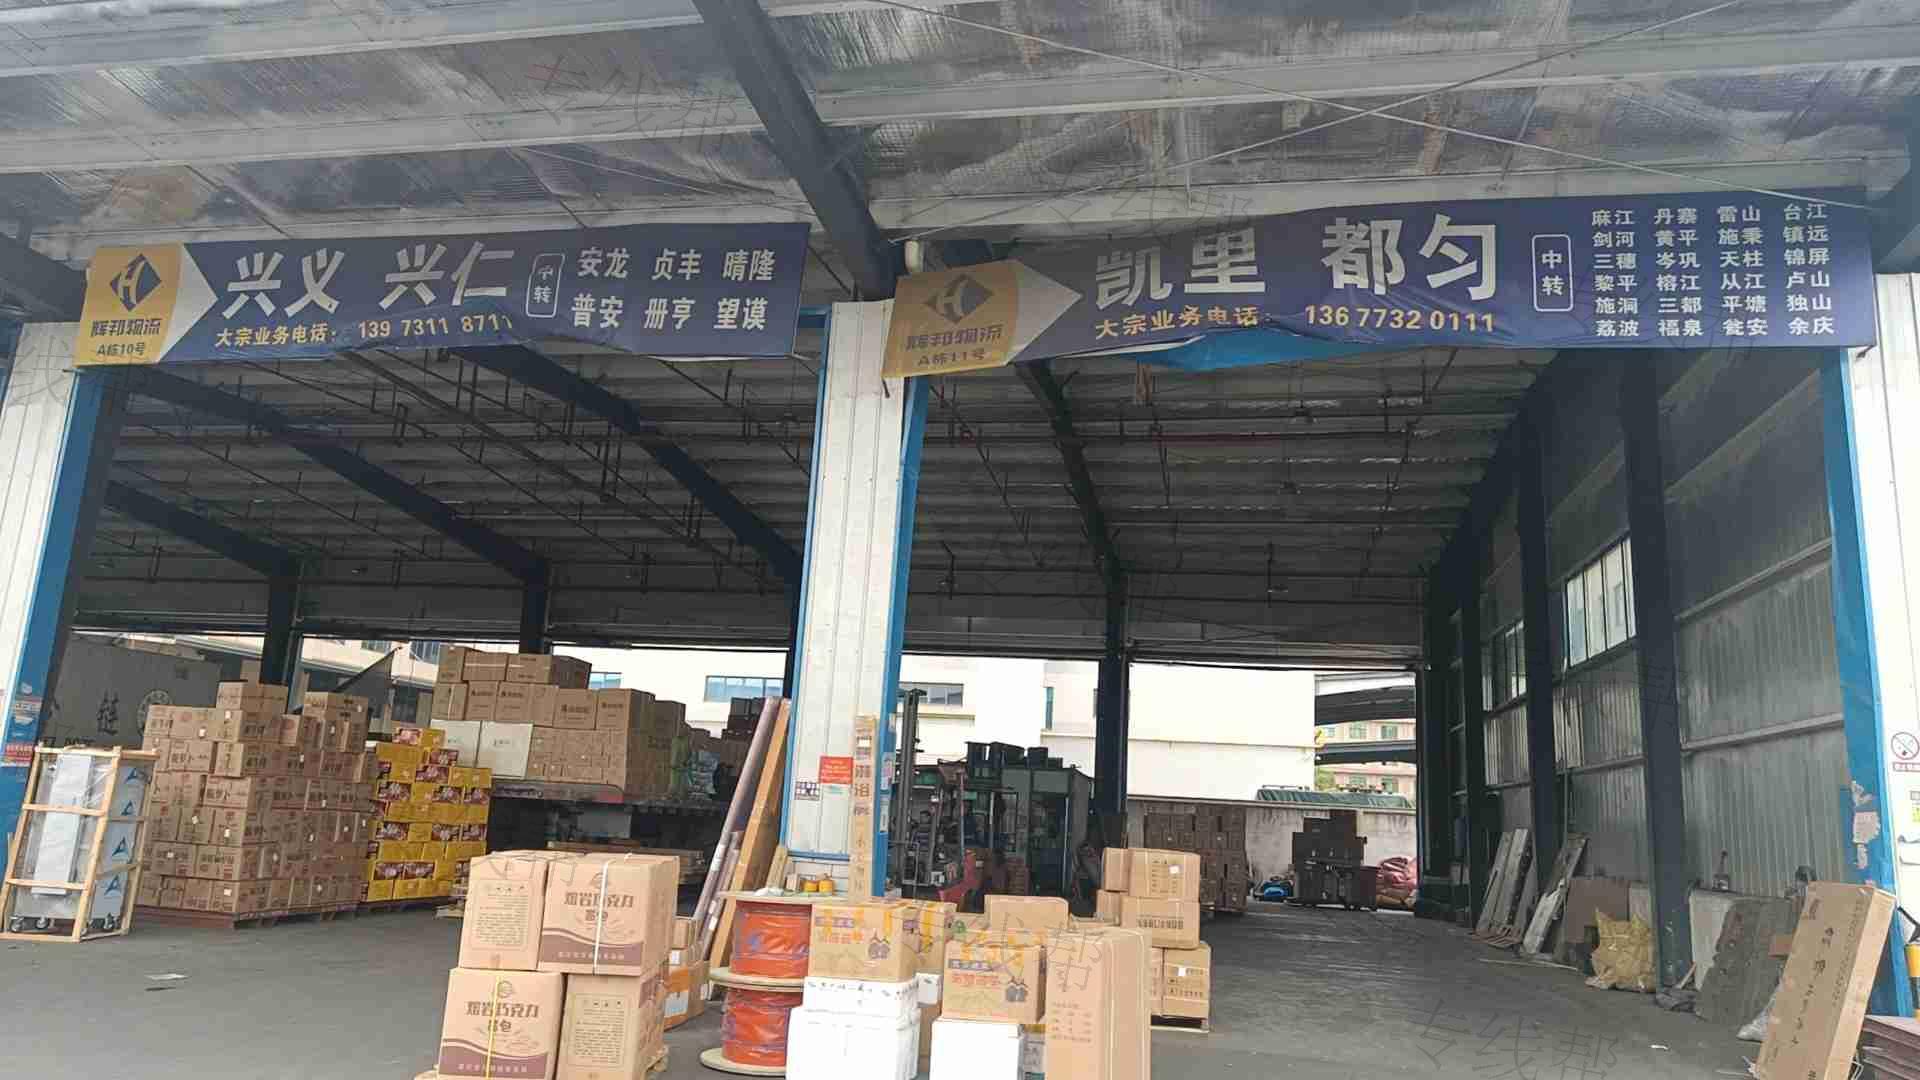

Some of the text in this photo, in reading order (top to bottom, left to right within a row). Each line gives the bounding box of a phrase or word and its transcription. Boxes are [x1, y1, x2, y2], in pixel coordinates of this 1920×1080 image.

[1592, 209, 1635, 226] 麻江
[1717, 205, 1761, 223] 雷山
[1784, 203, 1827, 219] 台江
[1592, 232, 1635, 248] 剑河
[1655, 230, 1698, 247] 黄平
[1783, 225, 1828, 243] 镇远
[577, 246, 776, 282] 安龙 贞丰 晴隆
[1096, 213, 1497, 311] 凯里 都匀
[1594, 247, 1830, 269] 三穗 岑巩 天柱 锦屏
[222, 241, 515, 320] 兴义 兴仁
[1541, 249, 1564, 296] 中转
[1656, 274, 1701, 291] 榕江
[1721, 273, 1764, 290] 从江
[571, 294, 768, 331] 普安 册亨 望谟
[1595, 294, 1832, 314] 施洞 三都 平塘 独山
[357, 319, 391, 339] 139
[400, 317, 449, 336] 7311
[1304, 304, 1350, 326] 136
[1357, 307, 1422, 330] 7732
[1430, 310, 1495, 332] 0111
[1596, 316, 1834, 337] 荔波 福泉 瓮安 余庆
